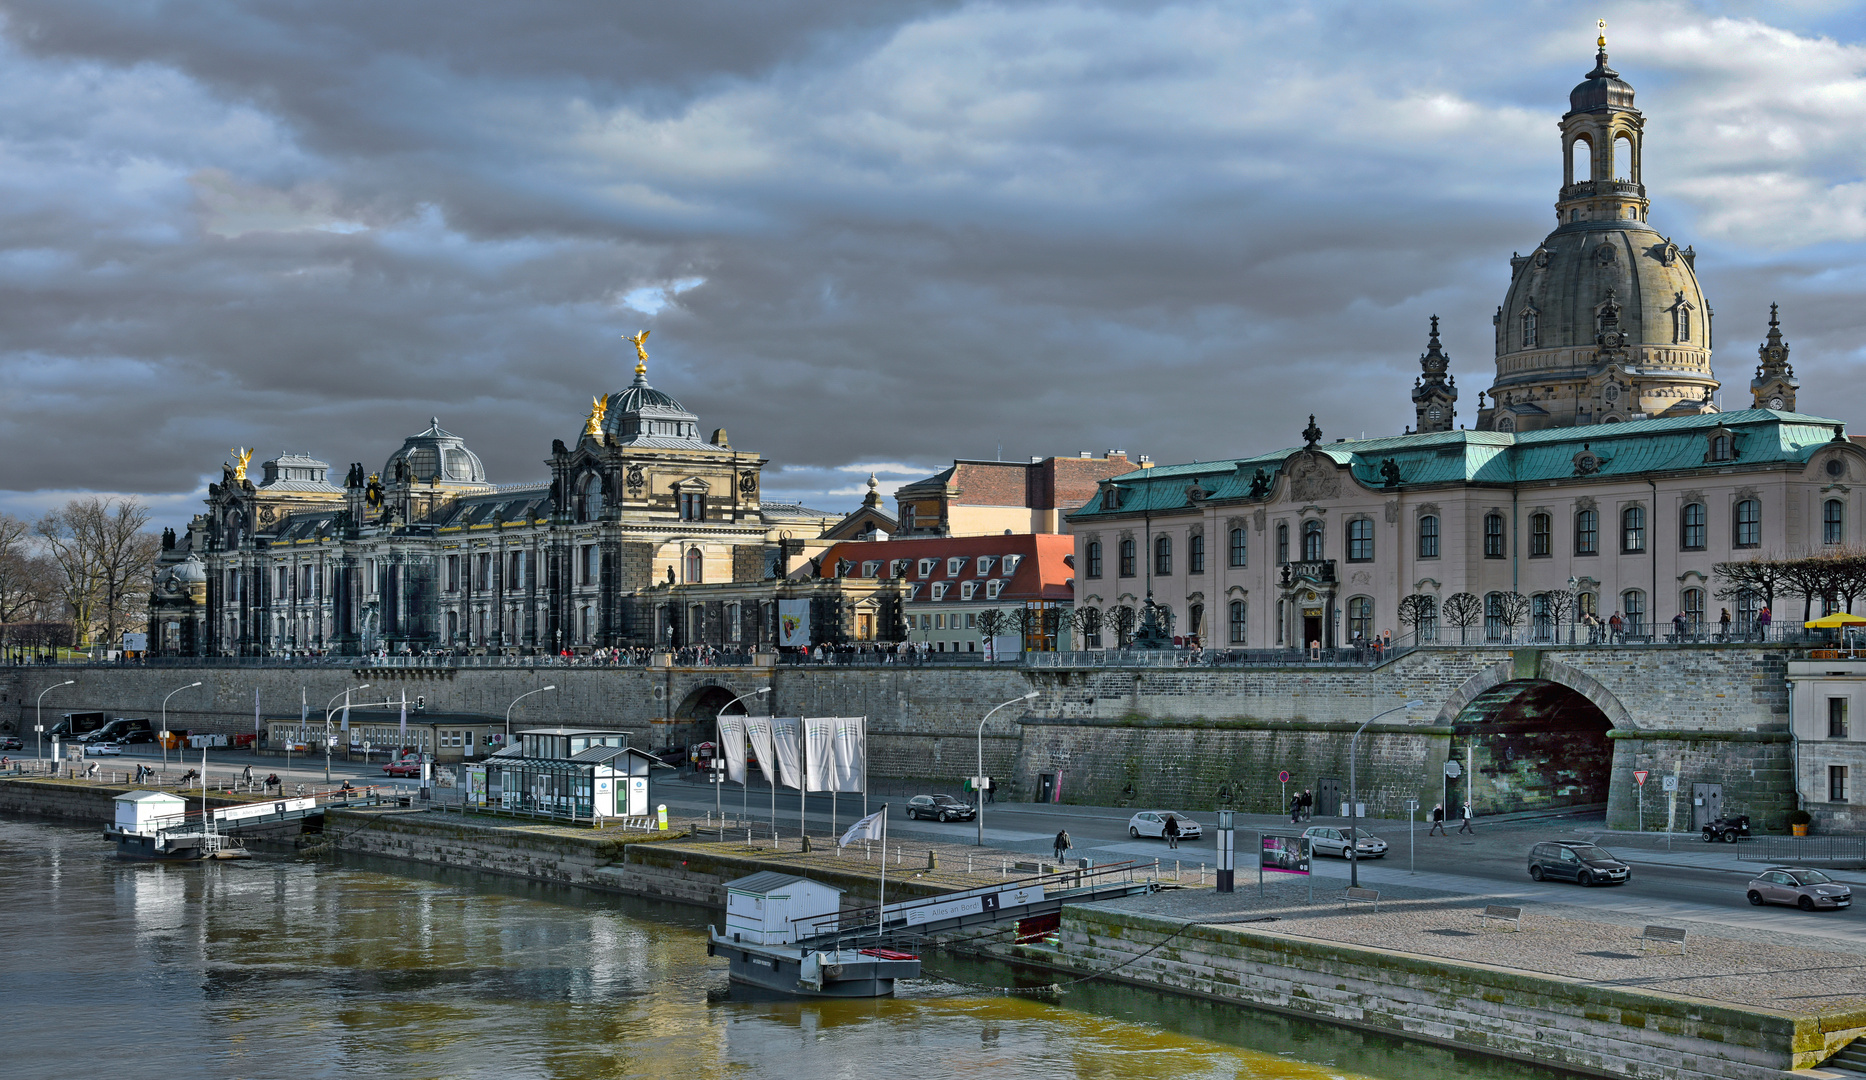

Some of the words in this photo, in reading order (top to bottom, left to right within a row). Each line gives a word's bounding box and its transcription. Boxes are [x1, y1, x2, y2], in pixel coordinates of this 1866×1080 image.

[987, 898, 994, 907] 1
[932, 908, 948, 916] Alles
[962, 902, 980, 912] Bord!
